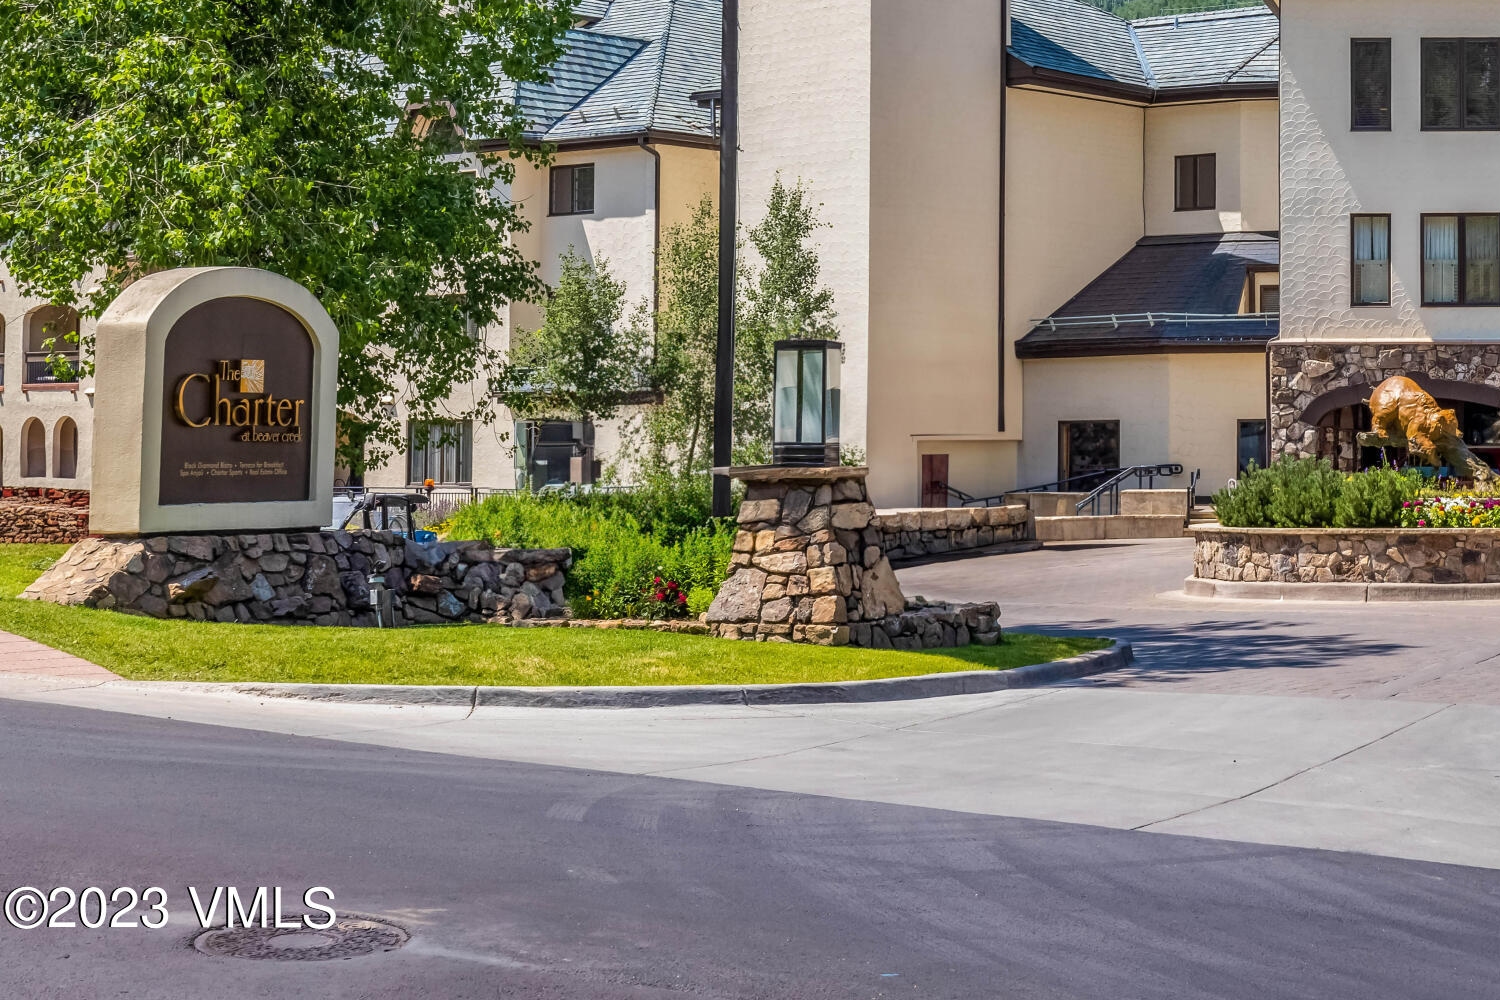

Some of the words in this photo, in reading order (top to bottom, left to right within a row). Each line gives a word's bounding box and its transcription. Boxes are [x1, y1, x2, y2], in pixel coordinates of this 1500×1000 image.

[219, 360, 241, 381] The
[177, 373, 305, 428] Charter
[241, 431, 250, 442] at
[252, 425, 280, 442] beaver
[281, 425, 303, 442] creek
